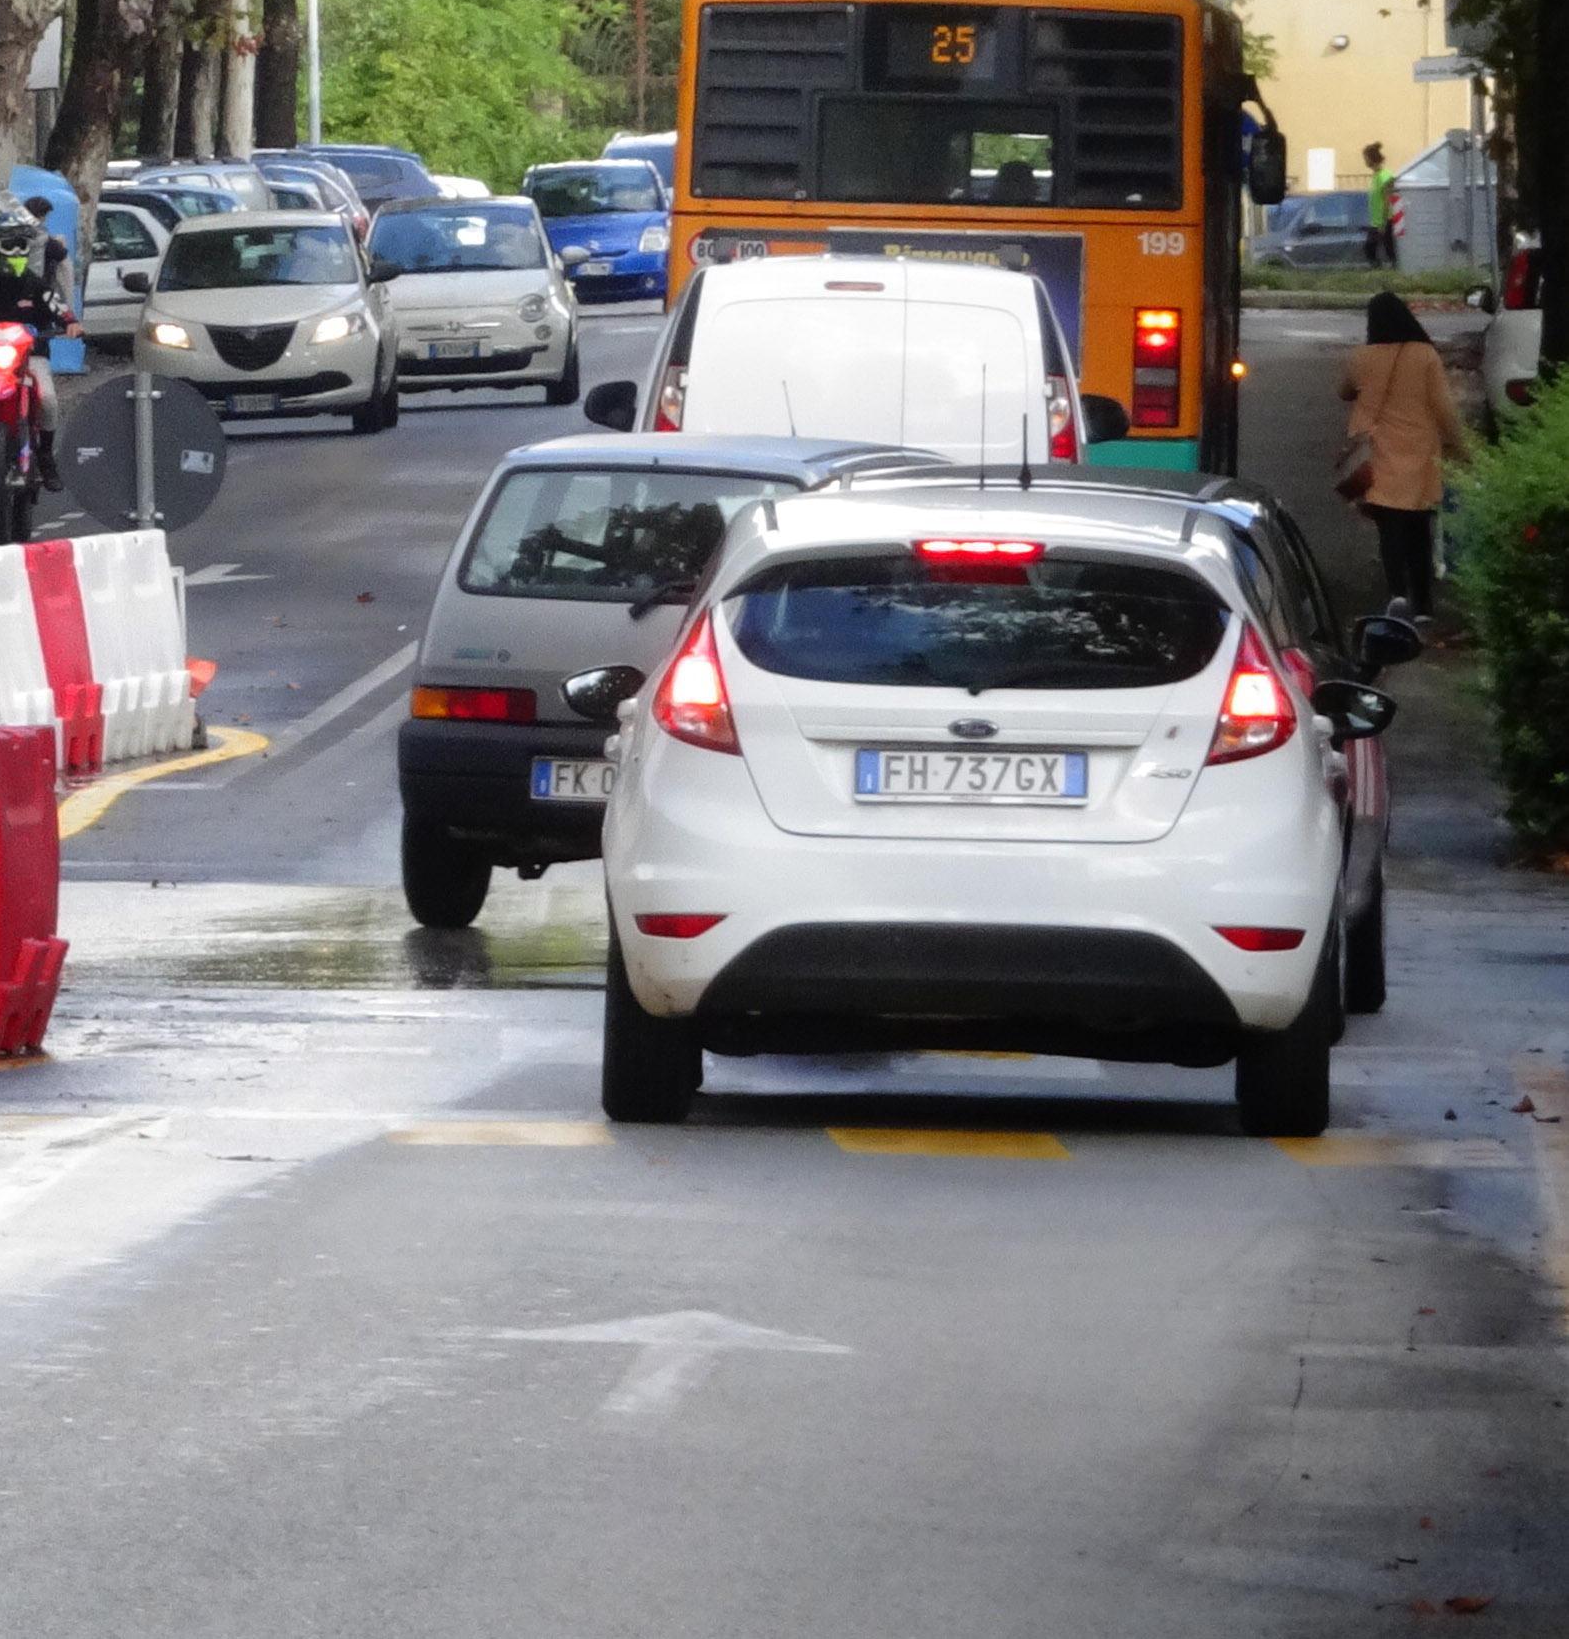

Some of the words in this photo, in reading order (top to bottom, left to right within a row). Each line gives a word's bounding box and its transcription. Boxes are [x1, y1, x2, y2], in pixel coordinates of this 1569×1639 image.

[932, 25, 975, 63] 25
[1137, 232, 1186, 255] 199
[601, 766, 616, 794] 0
